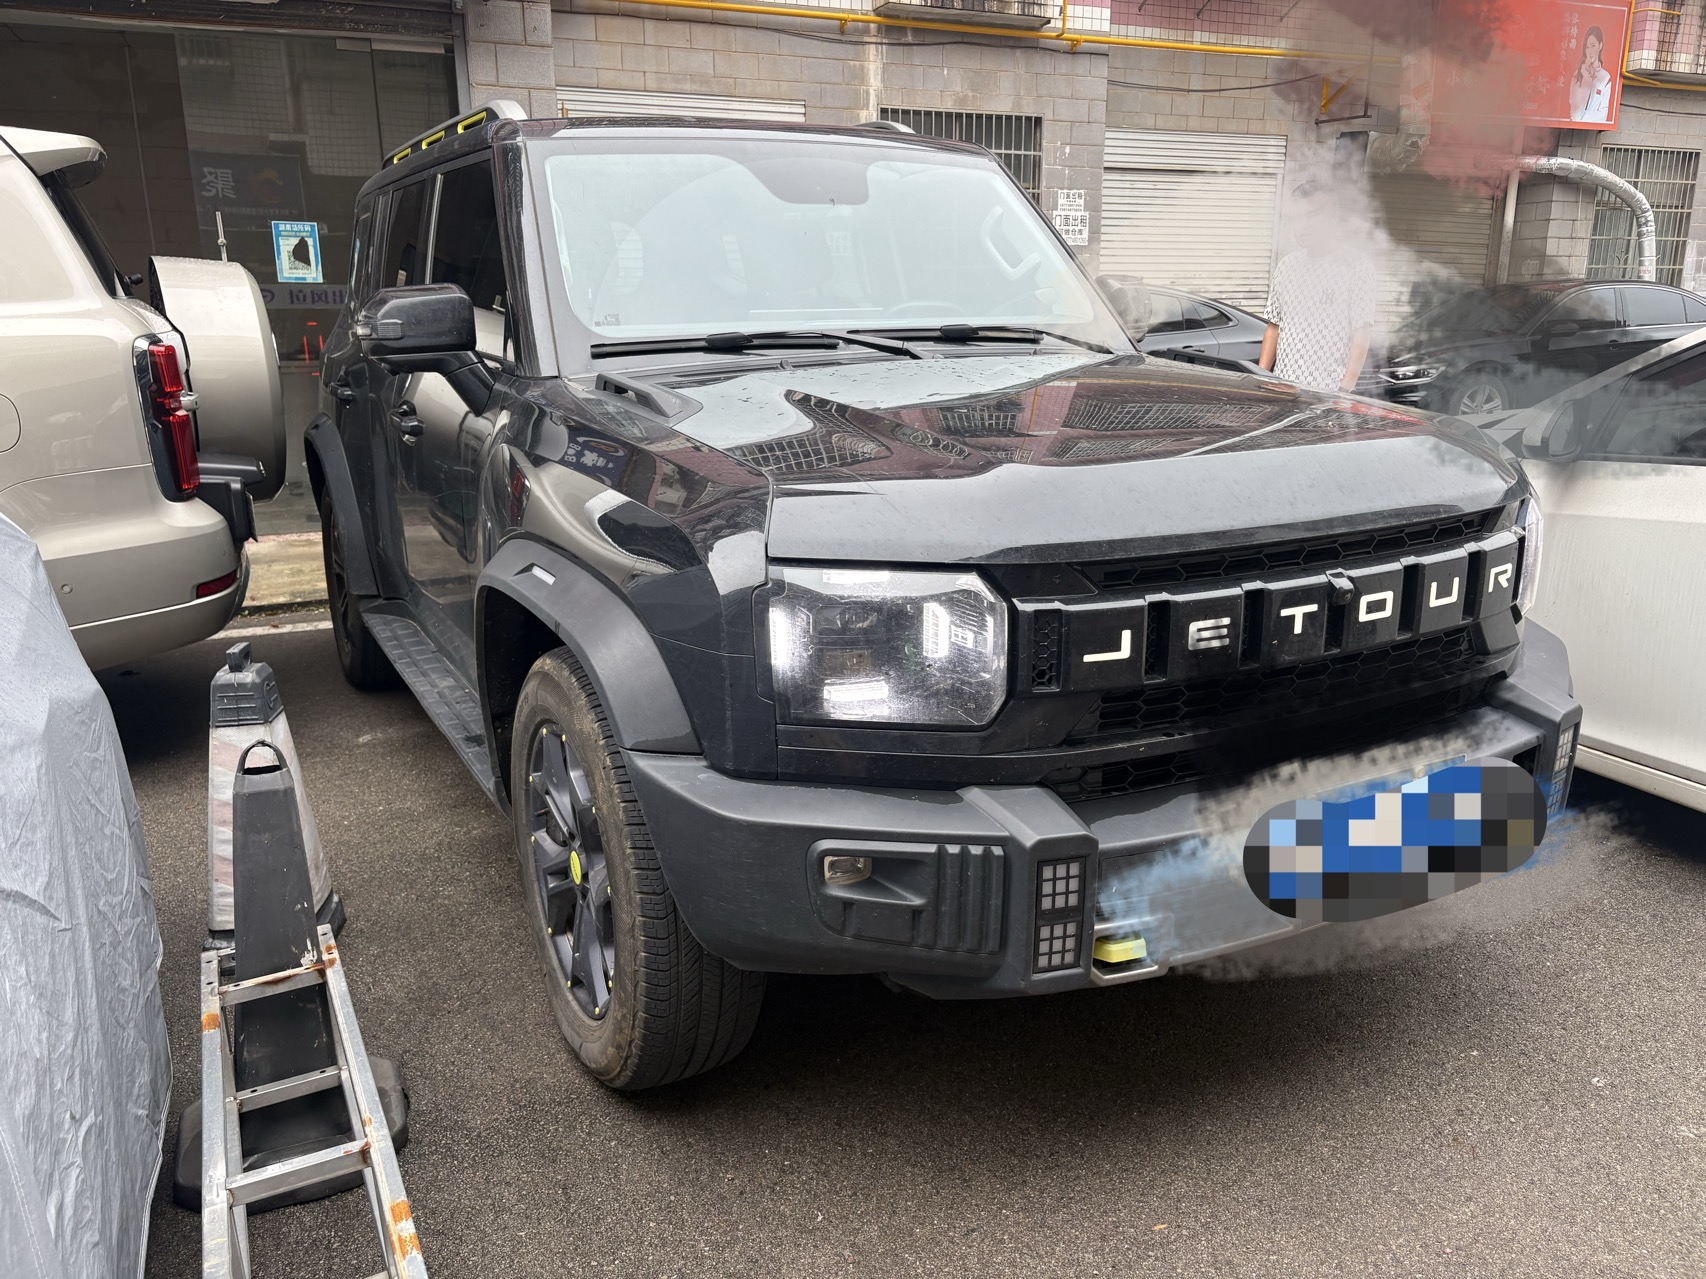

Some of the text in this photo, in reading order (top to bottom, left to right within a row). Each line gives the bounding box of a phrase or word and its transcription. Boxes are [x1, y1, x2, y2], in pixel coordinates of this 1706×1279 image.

[1055, 214, 1087, 227] 门面出租
[1082, 561, 1514, 664] JETOUR
